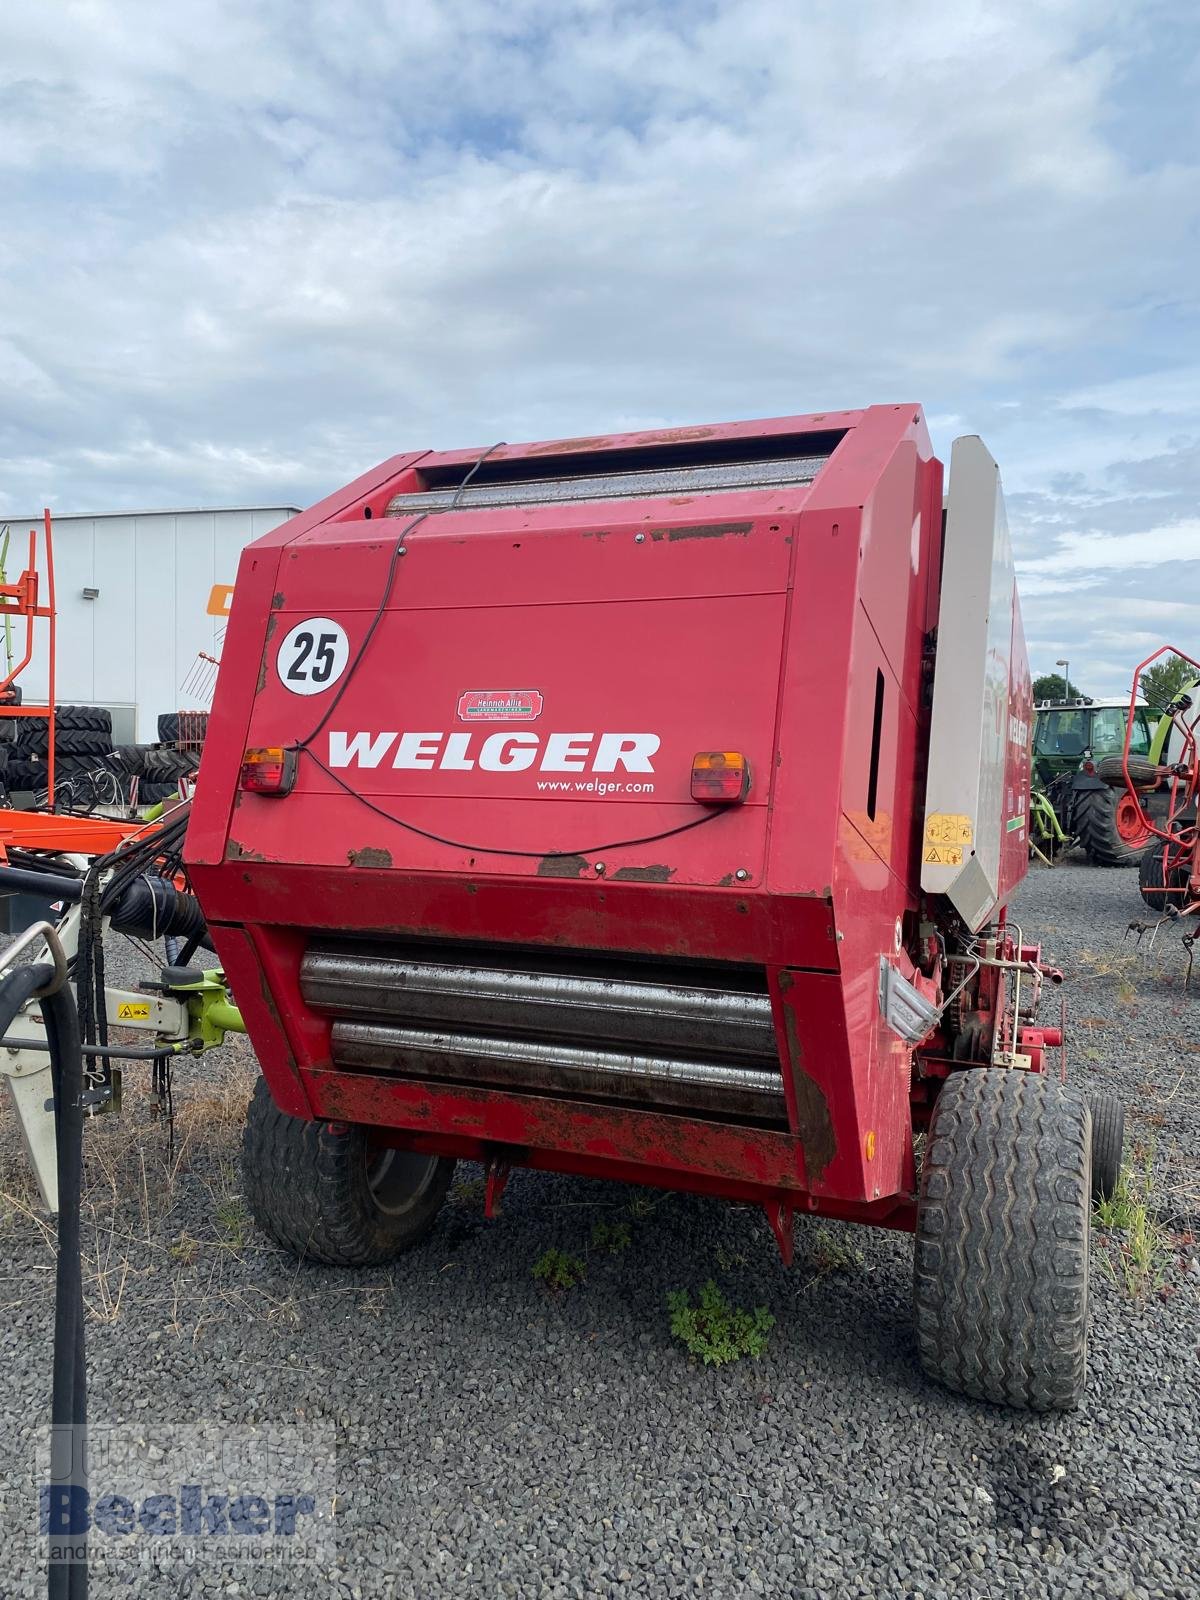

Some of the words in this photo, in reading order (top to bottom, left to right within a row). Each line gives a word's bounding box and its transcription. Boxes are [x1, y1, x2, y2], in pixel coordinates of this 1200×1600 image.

[287, 632, 338, 682] 25
[478, 699, 504, 707] Heinrich
[329, 731, 661, 773] WELGER
[536, 778, 655, 795] www.welger.com
